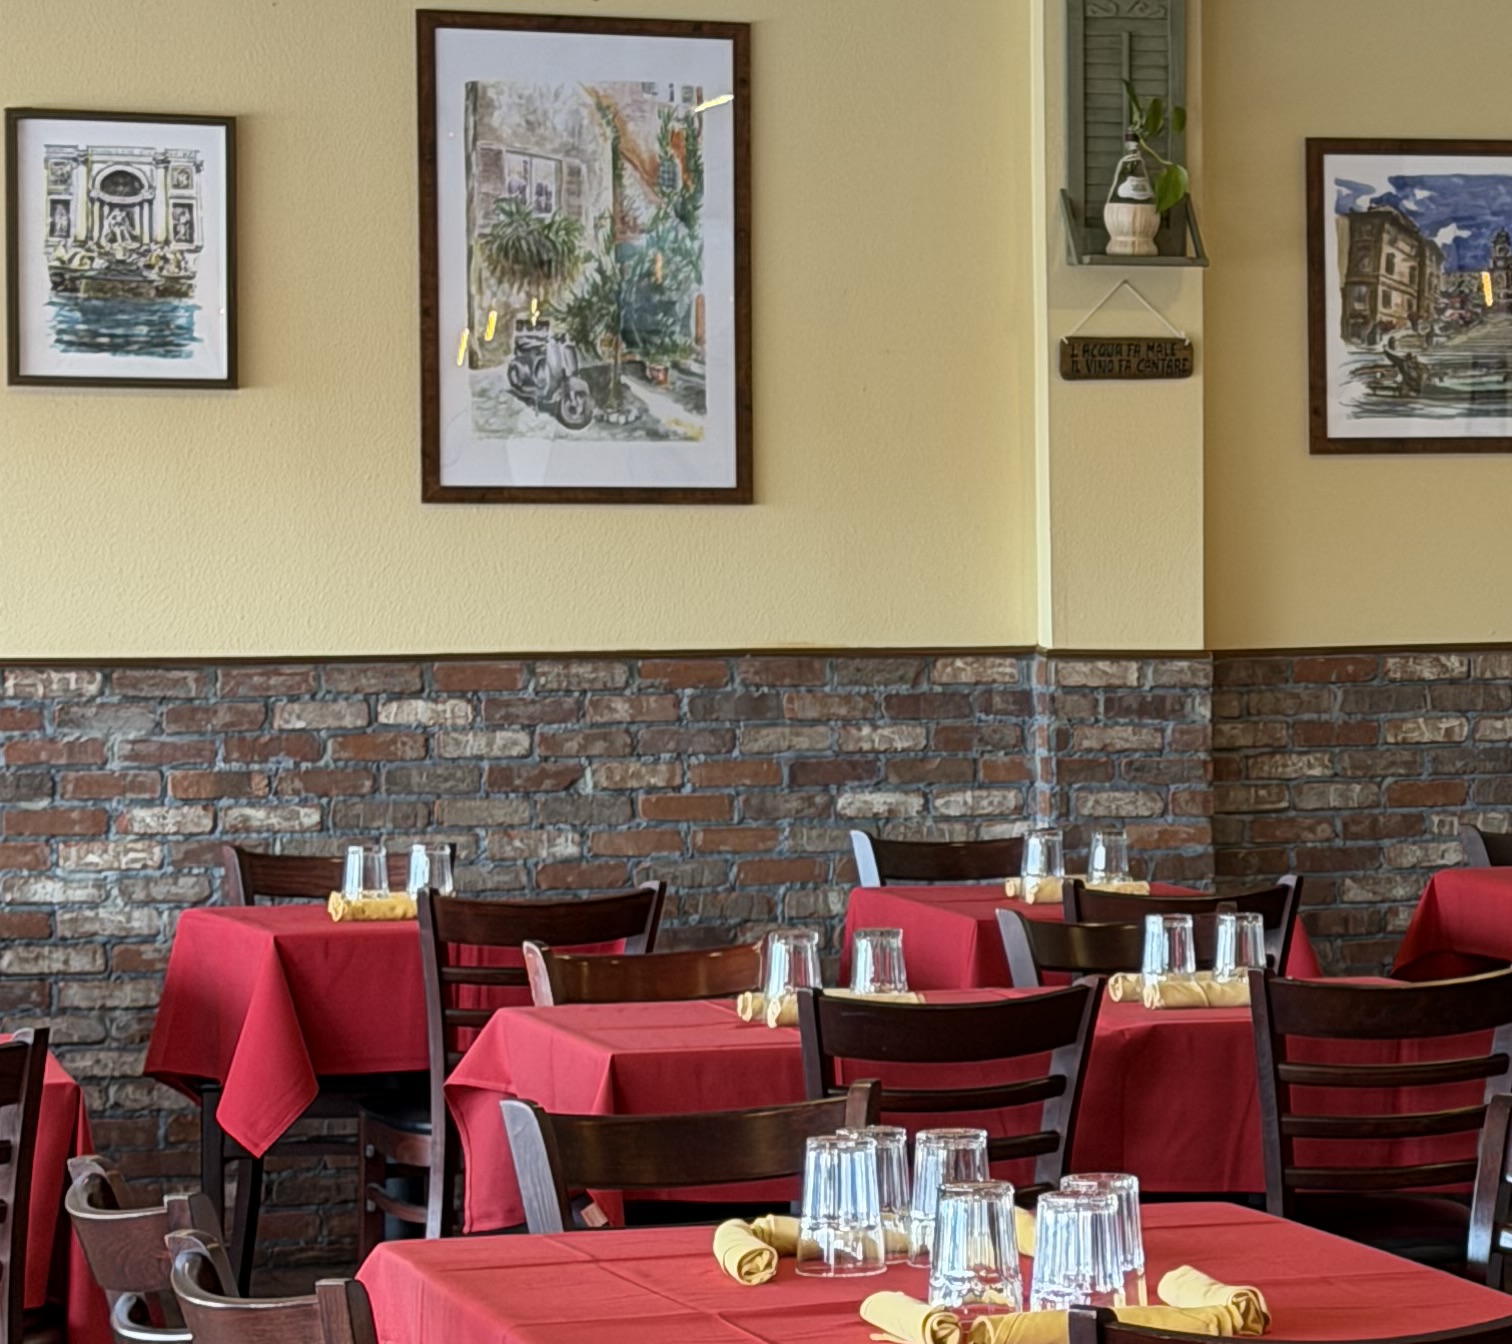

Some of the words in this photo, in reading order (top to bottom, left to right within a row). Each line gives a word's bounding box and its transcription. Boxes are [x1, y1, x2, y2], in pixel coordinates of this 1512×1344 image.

[1127, 343, 1141, 358] FA
[1146, 342, 1177, 359] MALE
[1085, 359, 1115, 374] VINO
